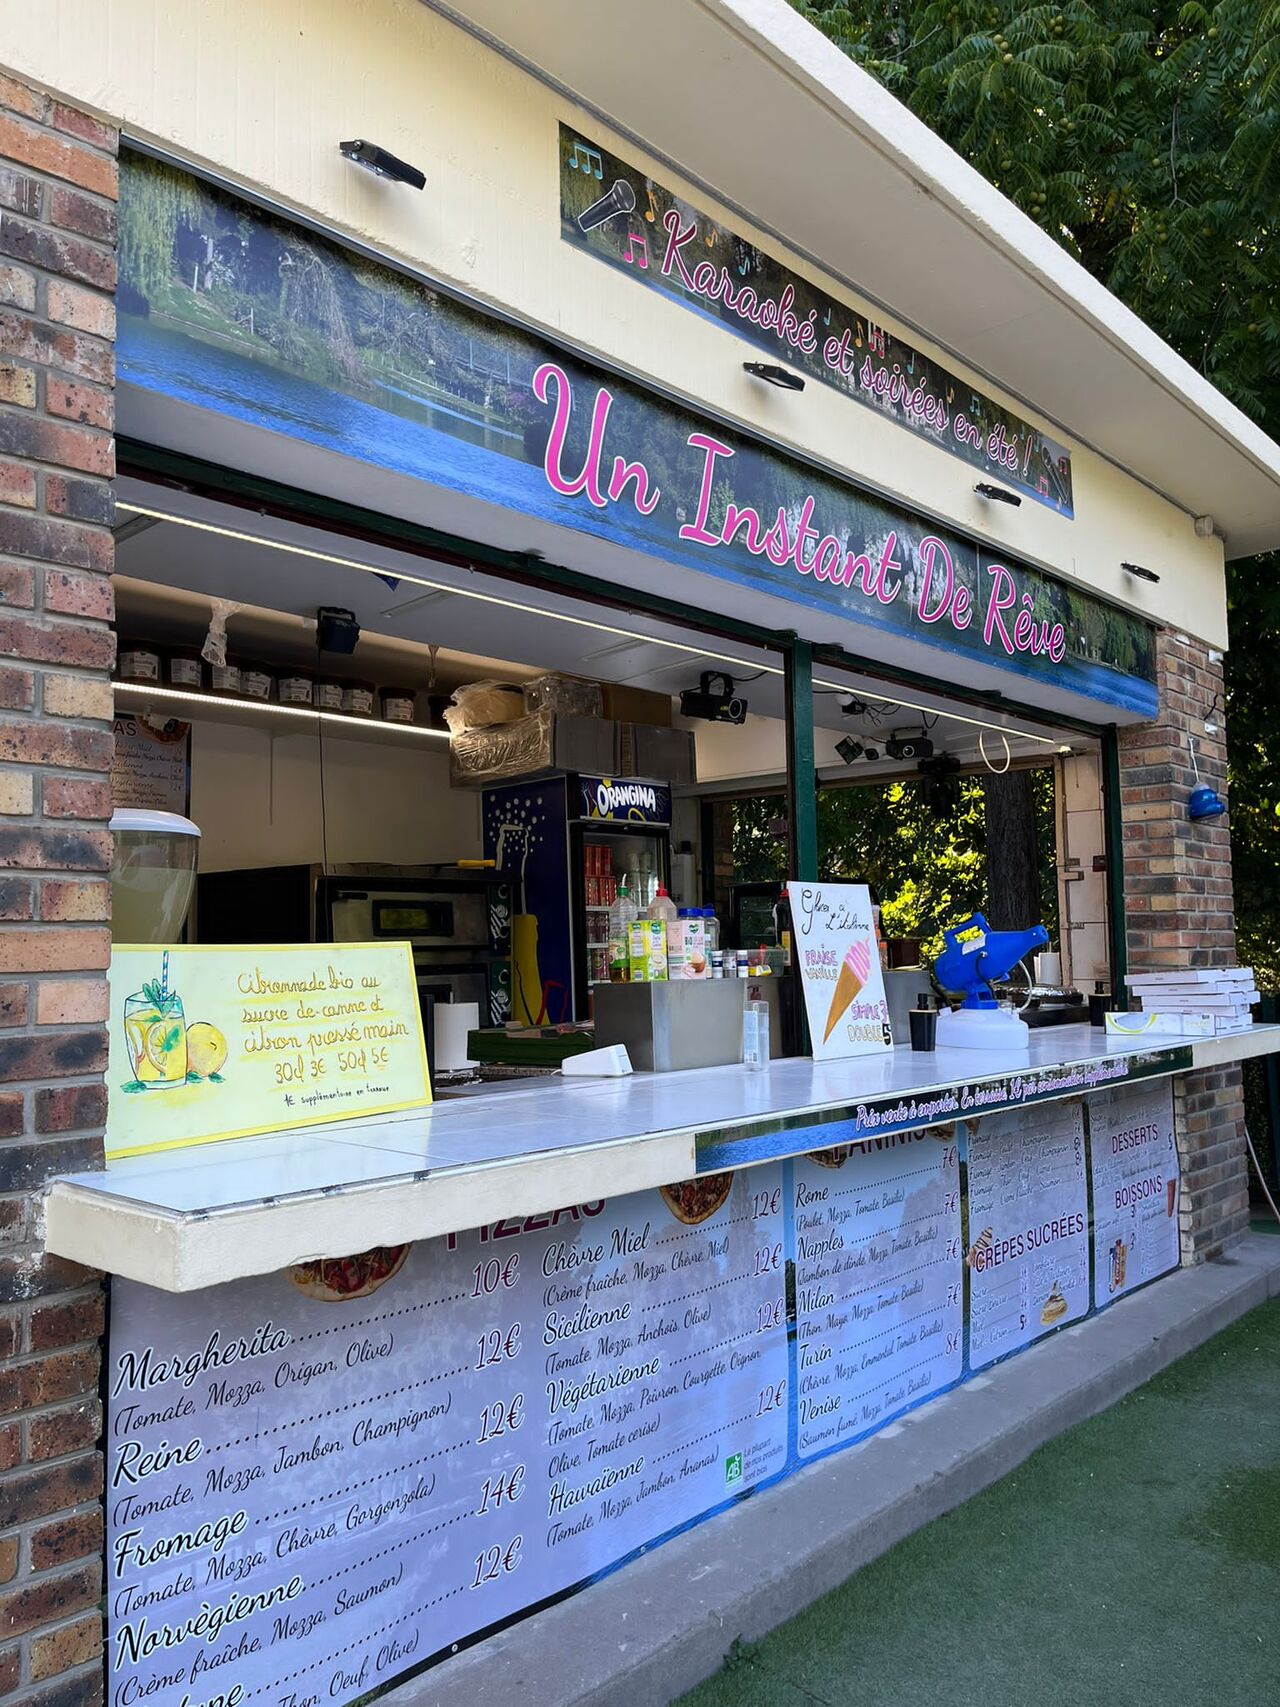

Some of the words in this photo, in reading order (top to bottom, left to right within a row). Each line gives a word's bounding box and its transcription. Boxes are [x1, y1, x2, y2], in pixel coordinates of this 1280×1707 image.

[661, 209, 817, 354] Karaoké
[823, 332, 857, 376] et
[860, 356, 949, 428] soirées
[953, 412, 983, 450] en
[986, 424, 1020, 474] été
[1022, 444, 1033, 477] !
[532, 362, 660, 515] Un
[678, 432, 901, 605] Instant
[916, 534, 974, 631] De
[982, 563, 1067, 664] Rêve
[597, 784, 657, 816] ORANGINA
[237, 966, 327, 995] Citronnade
[328, 964, 354, 990] bio
[361, 976, 381, 989] au
[241, 1007, 289, 1024] sucre
[370, 994, 384, 1011] et
[244, 1026, 302, 1053] citron
[307, 1022, 362, 1057] pressé
[363, 1020, 409, 1040] main
[310, 1058, 328, 1078] 3€
[371, 1046, 389, 1064] 5€
[847, 1024, 883, 1042] DOUBLE
[880, 1101, 909, 1125] vente
[1111, 1123, 1159, 1154] DESSERTS
[795, 1182, 830, 1208] Rome
[942, 1146, 957, 1169] 7€
[1115, 1175, 1163, 1209] BOISSONS
[541, 1239, 605, 1278] Chèvre
[609, 1221, 651, 1260] Miel
[751, 1187, 781, 1221] 12€
[797, 1228, 844, 1265] Napples
[944, 1191, 959, 1215] 7€
[975, 1234, 1024, 1273] CRÊPES
[1026, 1212, 1084, 1251] SUCRÉES
[543, 1301, 632, 1347] Sicilienne
[752, 1242, 783, 1278] 12€
[543, 1282, 584, 1308] (Crème
[798, 1285, 834, 1316] Milan
[946, 1238, 960, 1261] 7€
[831, 1261, 842, 1275] de
[112, 1319, 291, 1399] Margherita
[469, 1252, 520, 1299] 10€
[684, 1303, 713, 1330] Olive)
[800, 1343, 833, 1371] Turin
[947, 1282, 961, 1308] 7€
[113, 1397, 197, 1436] (Tomate,
[204, 1381, 266, 1412] Mozza,
[273, 1360, 338, 1390] Origan,
[345, 1332, 394, 1368] Olive)
[546, 1356, 660, 1416] Végétarienne
[755, 1297, 785, 1335] 12€
[800, 1395, 841, 1426] Venise
[945, 1329, 961, 1356] 8€
[112, 1435, 204, 1490] Reine
[473, 1322, 523, 1372] 12€
[113, 1484, 195, 1527] (Tomate,
[203, 1462, 266, 1499] Mozza,
[272, 1434, 345, 1475] Jambon,
[351, 1391, 453, 1449] Champignon)
[547, 1455, 645, 1519] Hawaïenne
[755, 1379, 787, 1419] 12€
[587, 1435, 626, 1463] Tomate
[627, 1413, 662, 1443] cerise)
[679, 1444, 720, 1480] Ananas)
[113, 1508, 249, 1580] Fromage
[475, 1393, 526, 1446] 12€
[475, 1465, 526, 1517] 14€
[113, 1576, 196, 1619] (Tomate,
[204, 1546, 268, 1587] Mozza,
[345, 1472, 436, 1532] Gorgonzola)
[469, 1535, 523, 1590] 12€
[114, 1672, 185, 1707] (Crème
[189, 1631, 262, 1686] fraîche,
[270, 1604, 328, 1650] Mozza,
[333, 1561, 404, 1616] Saumon)
[375, 1628, 420, 1672] Olive)
